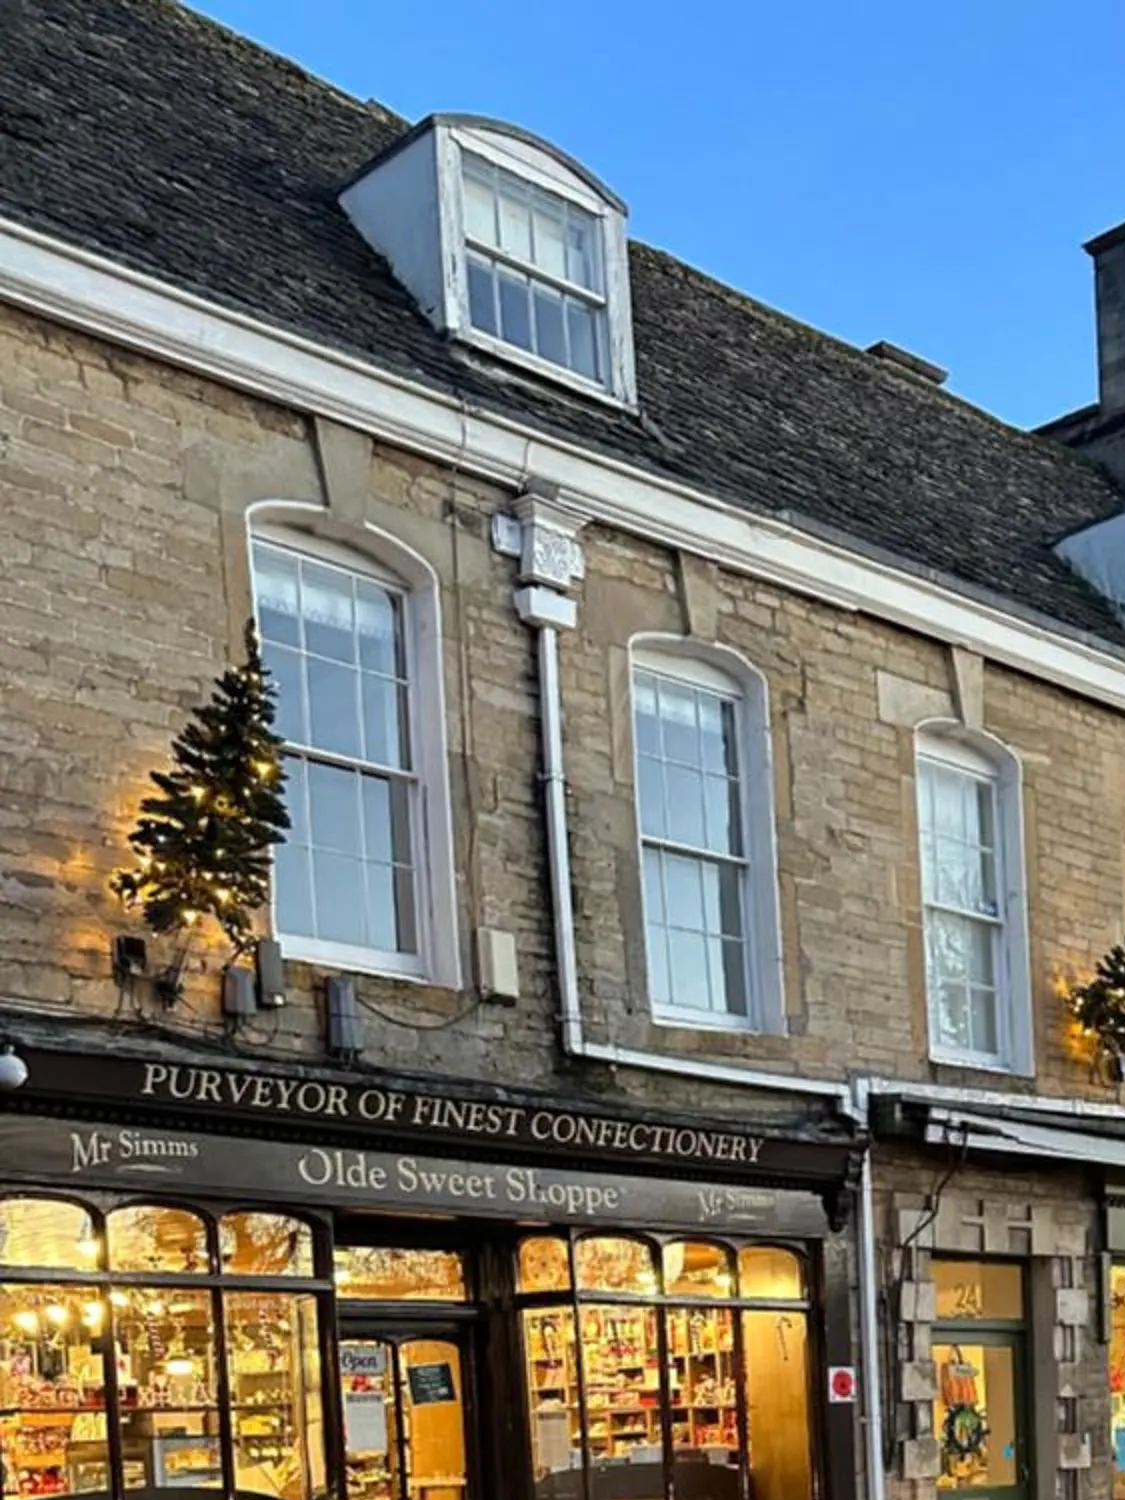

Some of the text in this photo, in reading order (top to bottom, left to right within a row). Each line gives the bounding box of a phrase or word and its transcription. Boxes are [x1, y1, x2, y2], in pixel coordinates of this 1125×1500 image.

[141, 1063, 764, 1164] PURVEYOR OF FINEST CONFECTIONERY
[70, 1129, 199, 1173] Mr Simms
[298, 1147, 619, 1215] Olde Sweet Shoppe
[953, 1282, 978, 1308] 24
